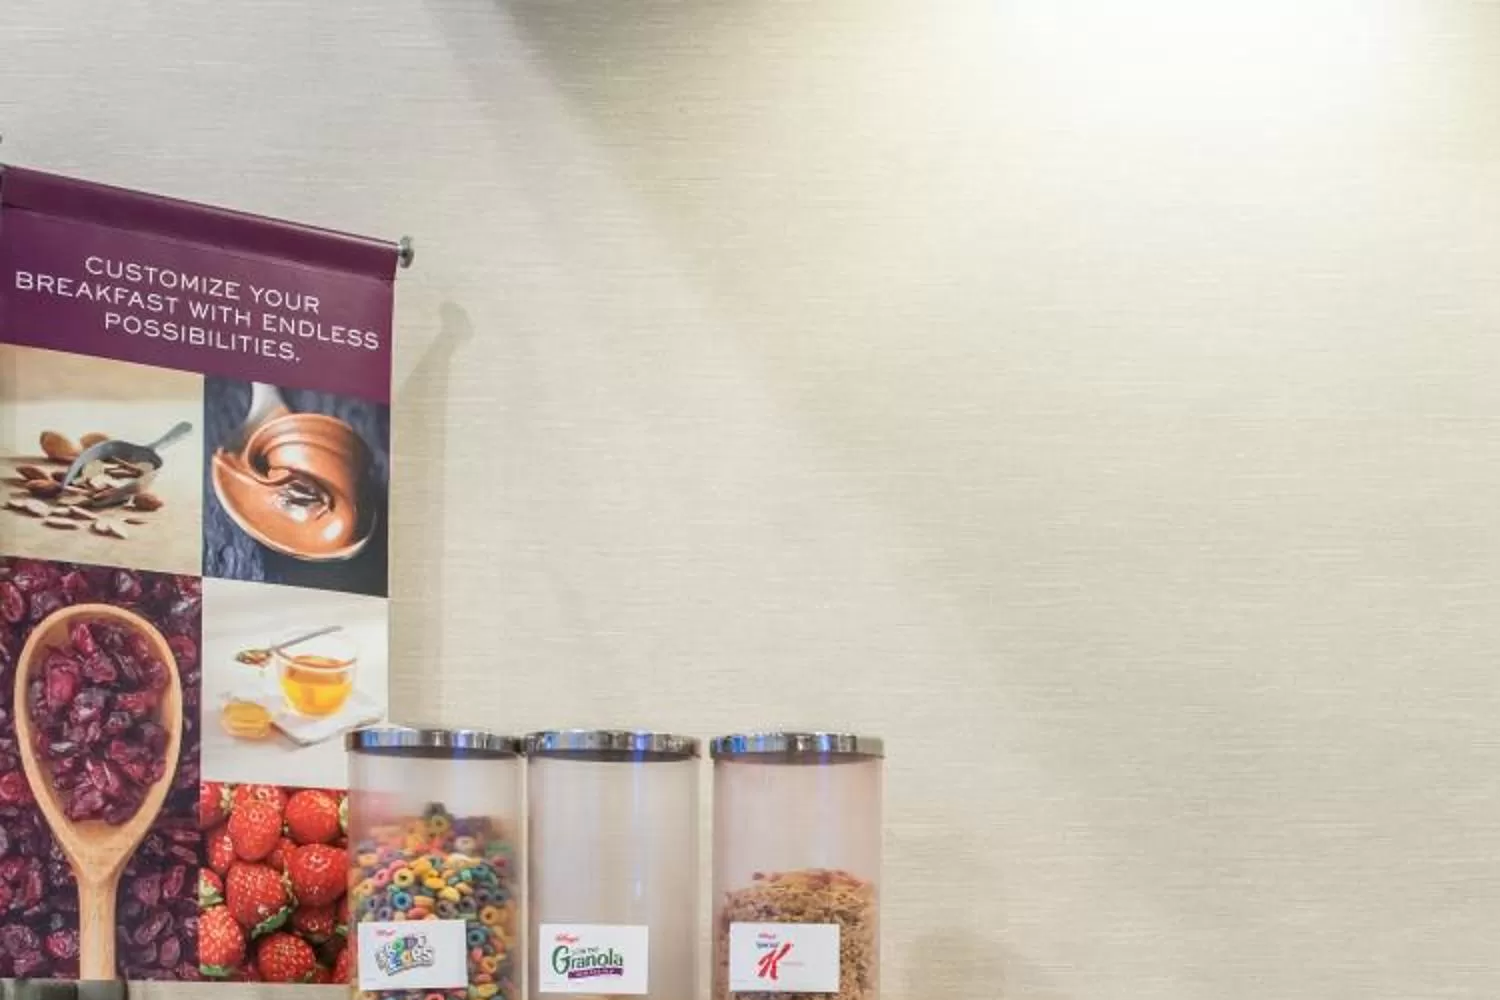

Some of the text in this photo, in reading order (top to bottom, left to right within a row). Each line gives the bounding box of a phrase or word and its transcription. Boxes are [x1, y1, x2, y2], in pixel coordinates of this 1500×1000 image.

[85, 256, 320, 314] CUSTOMIZE YOUR
[15, 271, 379, 350] BREAKFAST WITH ENDLESS
[105, 312, 301, 361] POSSIBILITIES.
[552, 945, 624, 975] Granola
[757, 943, 792, 980] K
